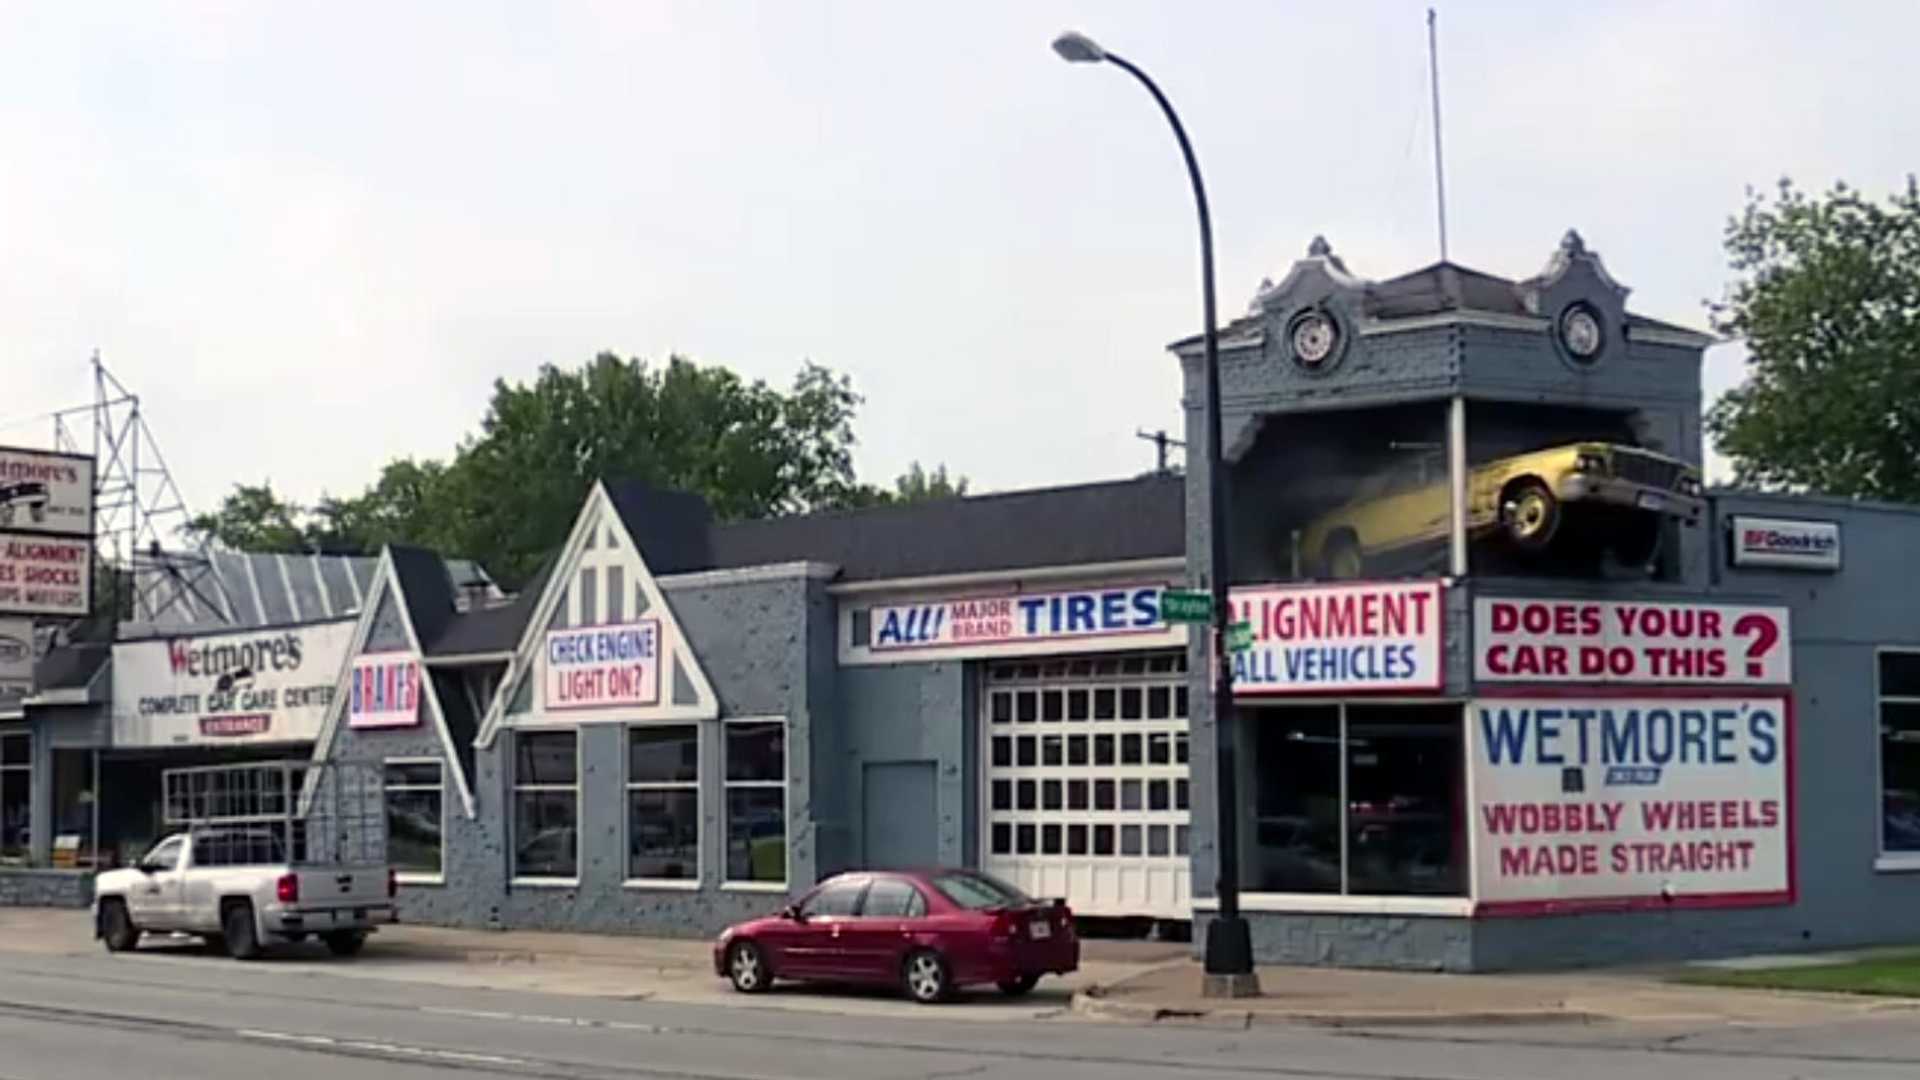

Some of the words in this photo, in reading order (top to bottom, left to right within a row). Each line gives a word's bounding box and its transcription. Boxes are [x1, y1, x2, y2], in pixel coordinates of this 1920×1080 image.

[7, 544, 85, 562] ALIGNMENT
[25, 566, 80, 585] SHOCKS
[951, 600, 1010, 619] MAJOR
[1018, 589, 1158, 634] TIRES
[1490, 603, 1602, 636] DOES
[1616, 606, 1722, 638] YOUR
[550, 635, 595, 665] CHECK
[597, 628, 652, 661] ENGINE
[952, 620, 1012, 640] BRAND
[1233, 647, 1277, 683] ALL
[1285, 645, 1416, 681] VEHICLES
[1486, 645, 1569, 676] CAR
[1579, 647, 1635, 676] DO
[1645, 648, 1727, 677] THIS
[352, 662, 416, 714] BRAKES
[559, 668, 604, 700] LIGHT
[608, 662, 642, 697] ON?
[138, 694, 200, 716] COMPLETE
[241, 689, 277, 711] CARE
[1480, 703, 1778, 765] WETMORE'S
[1483, 802, 1624, 835] WOBBLY
[1641, 800, 1779, 831] WHEELS
[1500, 845, 1598, 876] MADE
[1611, 842, 1755, 874] STRAIGHT
